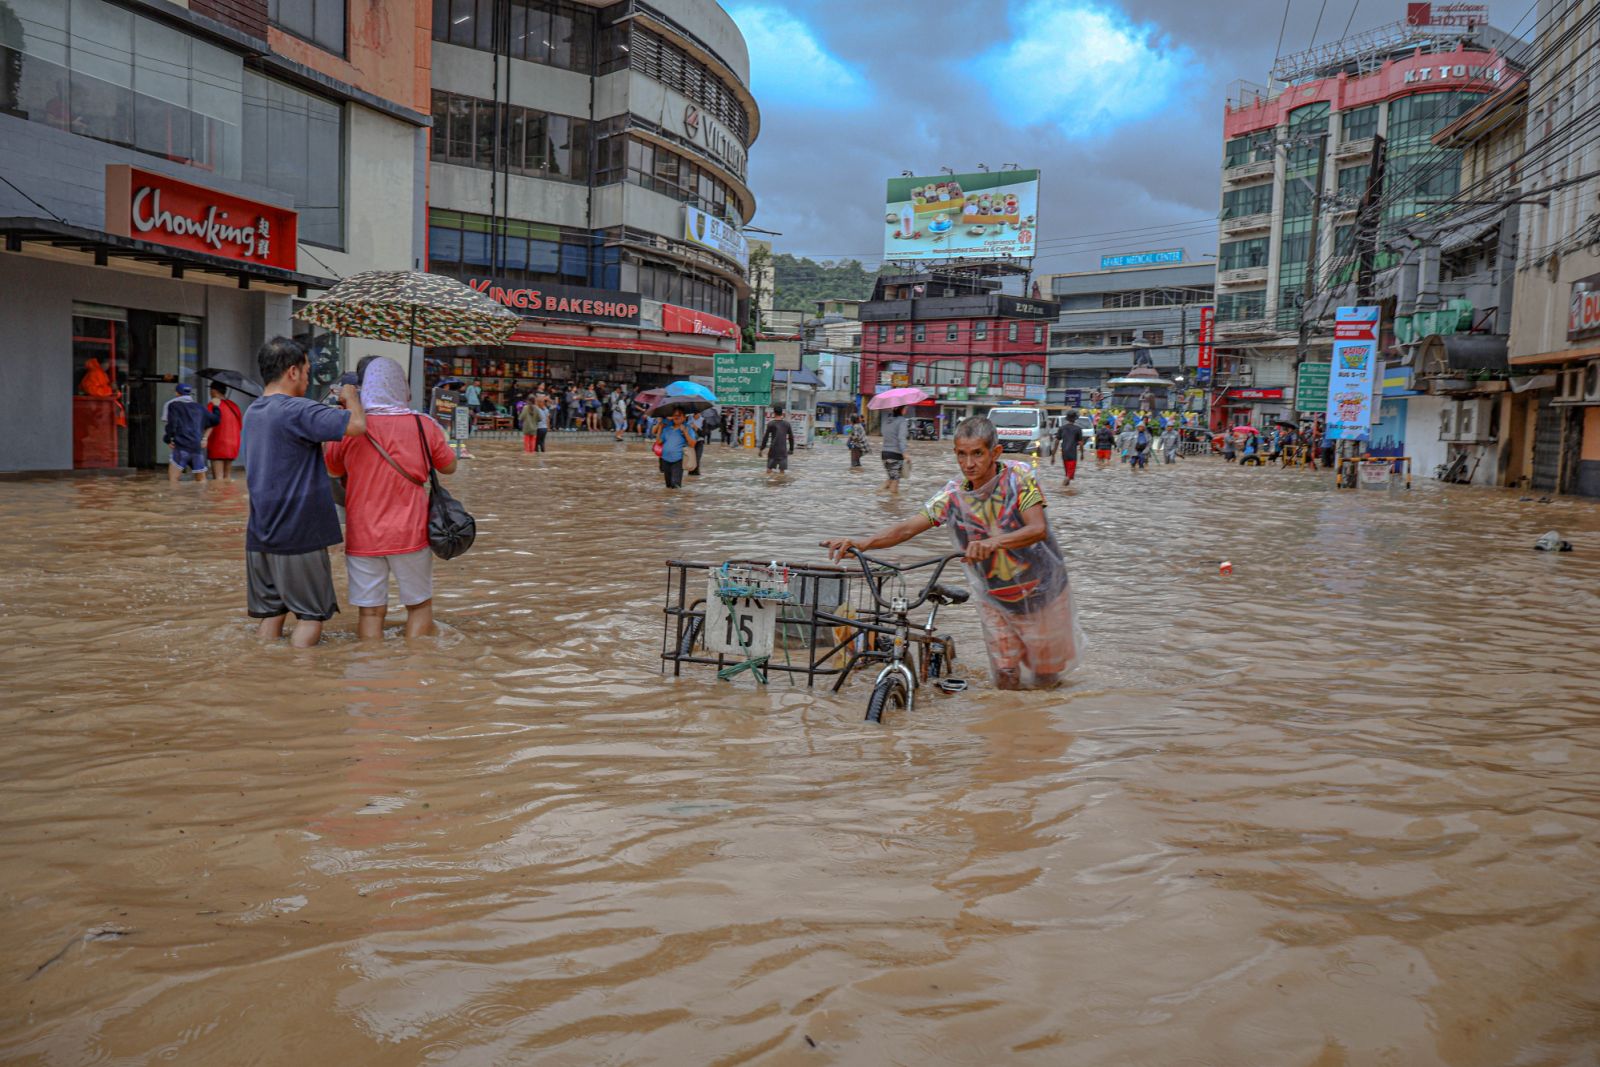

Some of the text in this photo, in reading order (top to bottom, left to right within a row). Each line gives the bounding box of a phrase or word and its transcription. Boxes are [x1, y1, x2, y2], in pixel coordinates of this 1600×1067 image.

[1430, 15, 1488, 26] HOTEL
[132, 187, 255, 256] Chowking
[545, 296, 638, 318] BAKESHOP
[738, 376, 751, 384] City
[725, 613, 753, 647] 15
